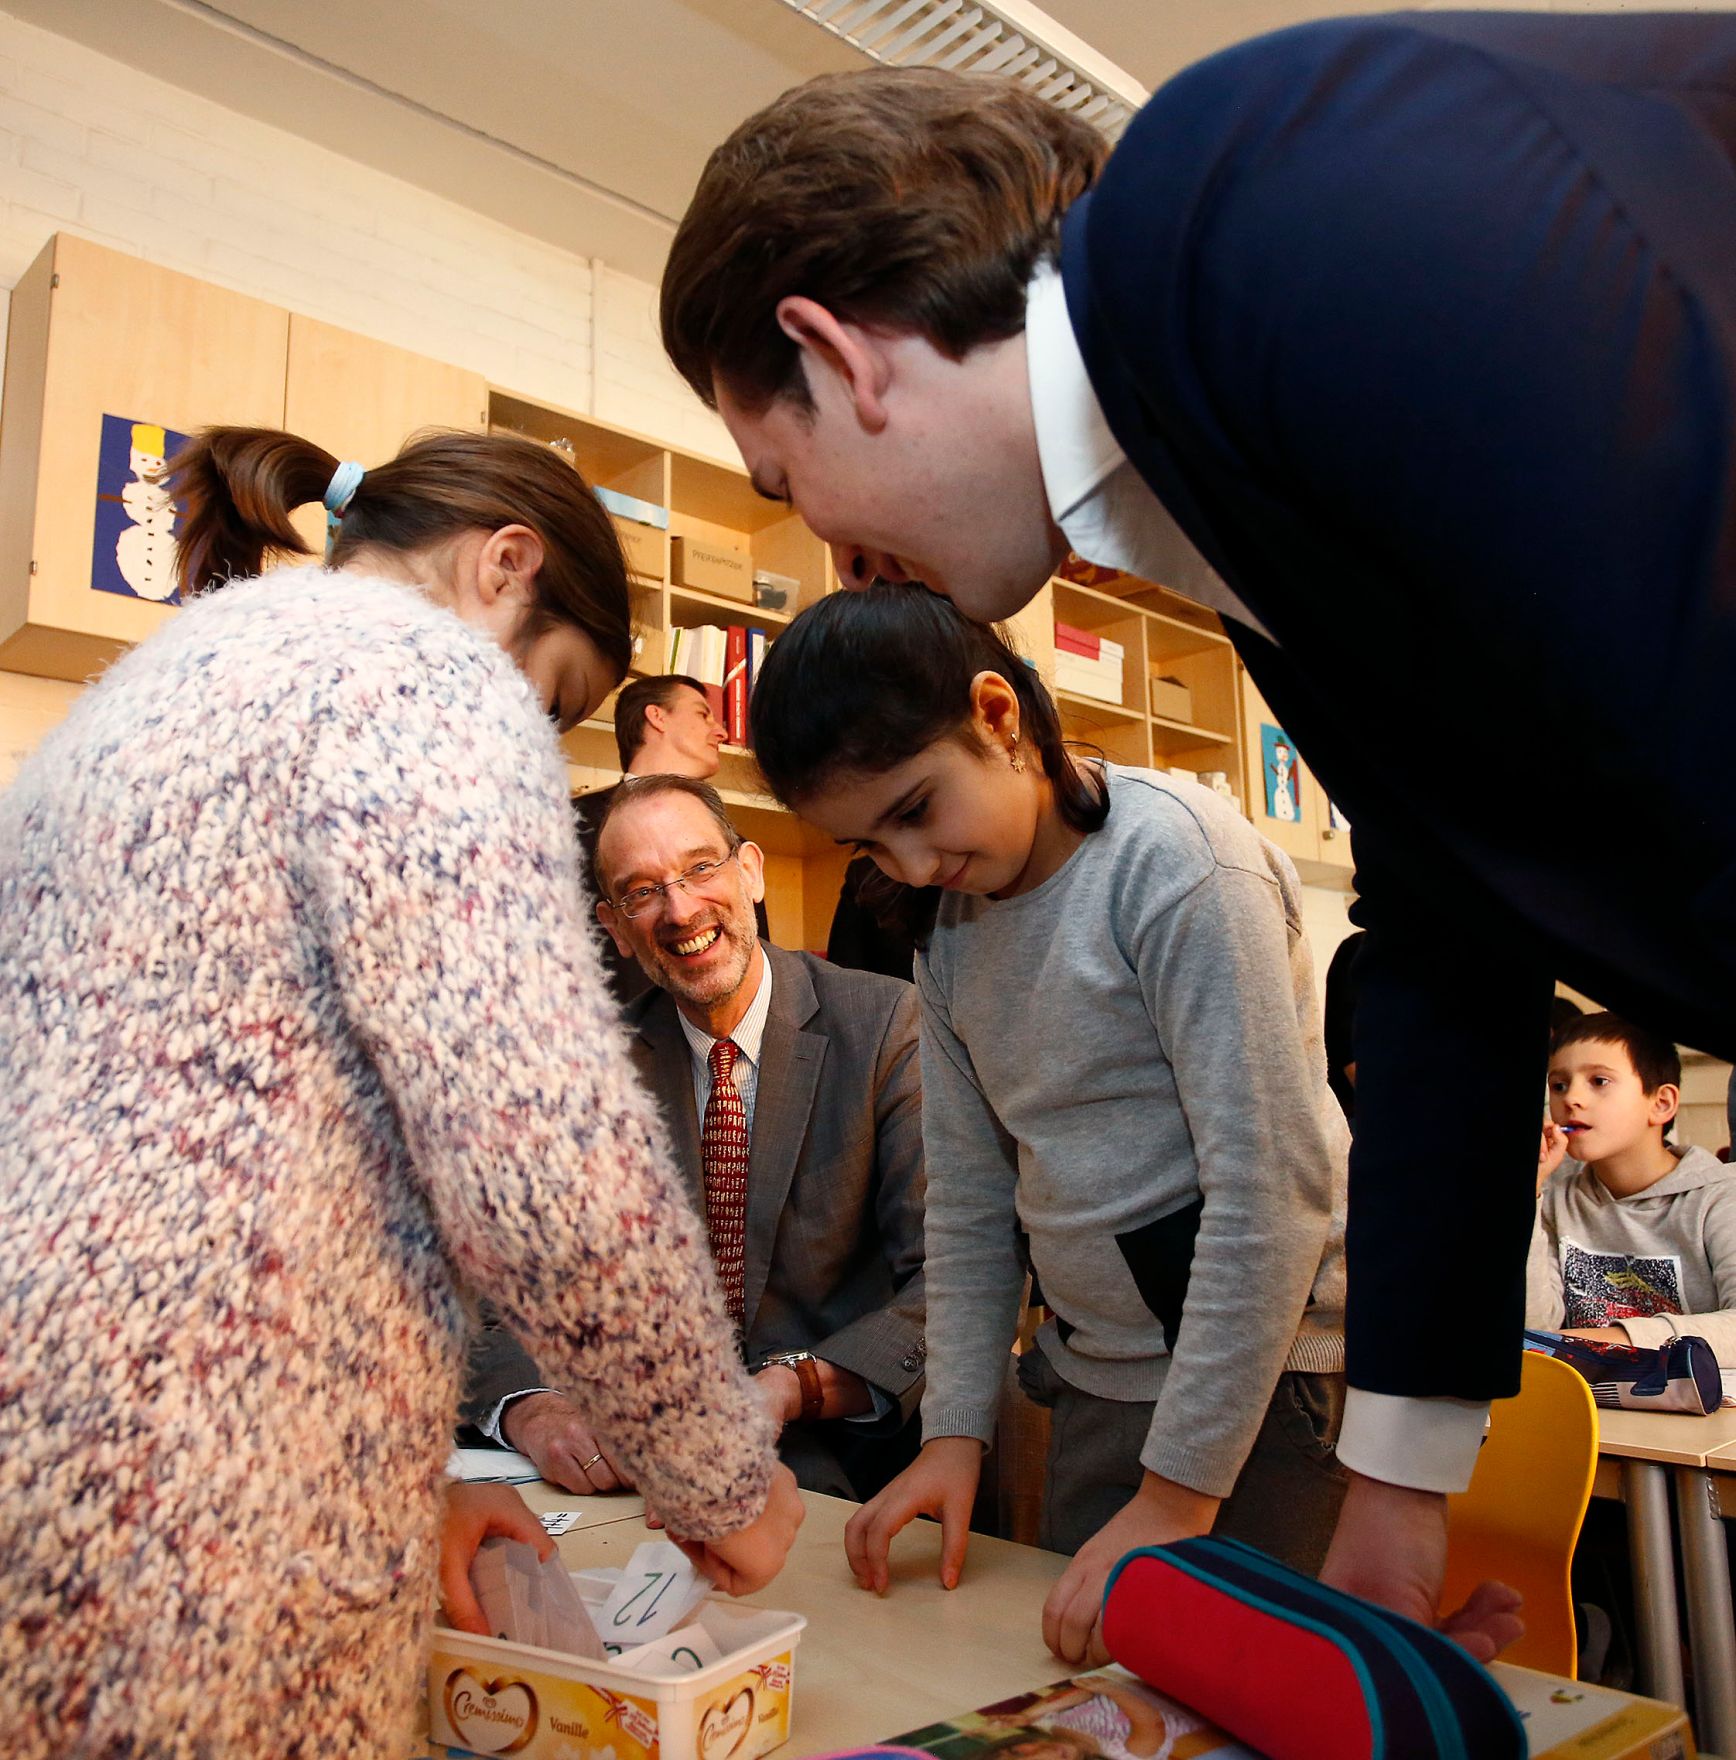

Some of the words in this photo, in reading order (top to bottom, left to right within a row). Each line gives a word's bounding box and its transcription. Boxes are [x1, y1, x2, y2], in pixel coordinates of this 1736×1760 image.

[613, 1572, 677, 1627] 12
[453, 1690, 525, 1728] Cremissimo
[549, 1716, 590, 1739] Vanille
